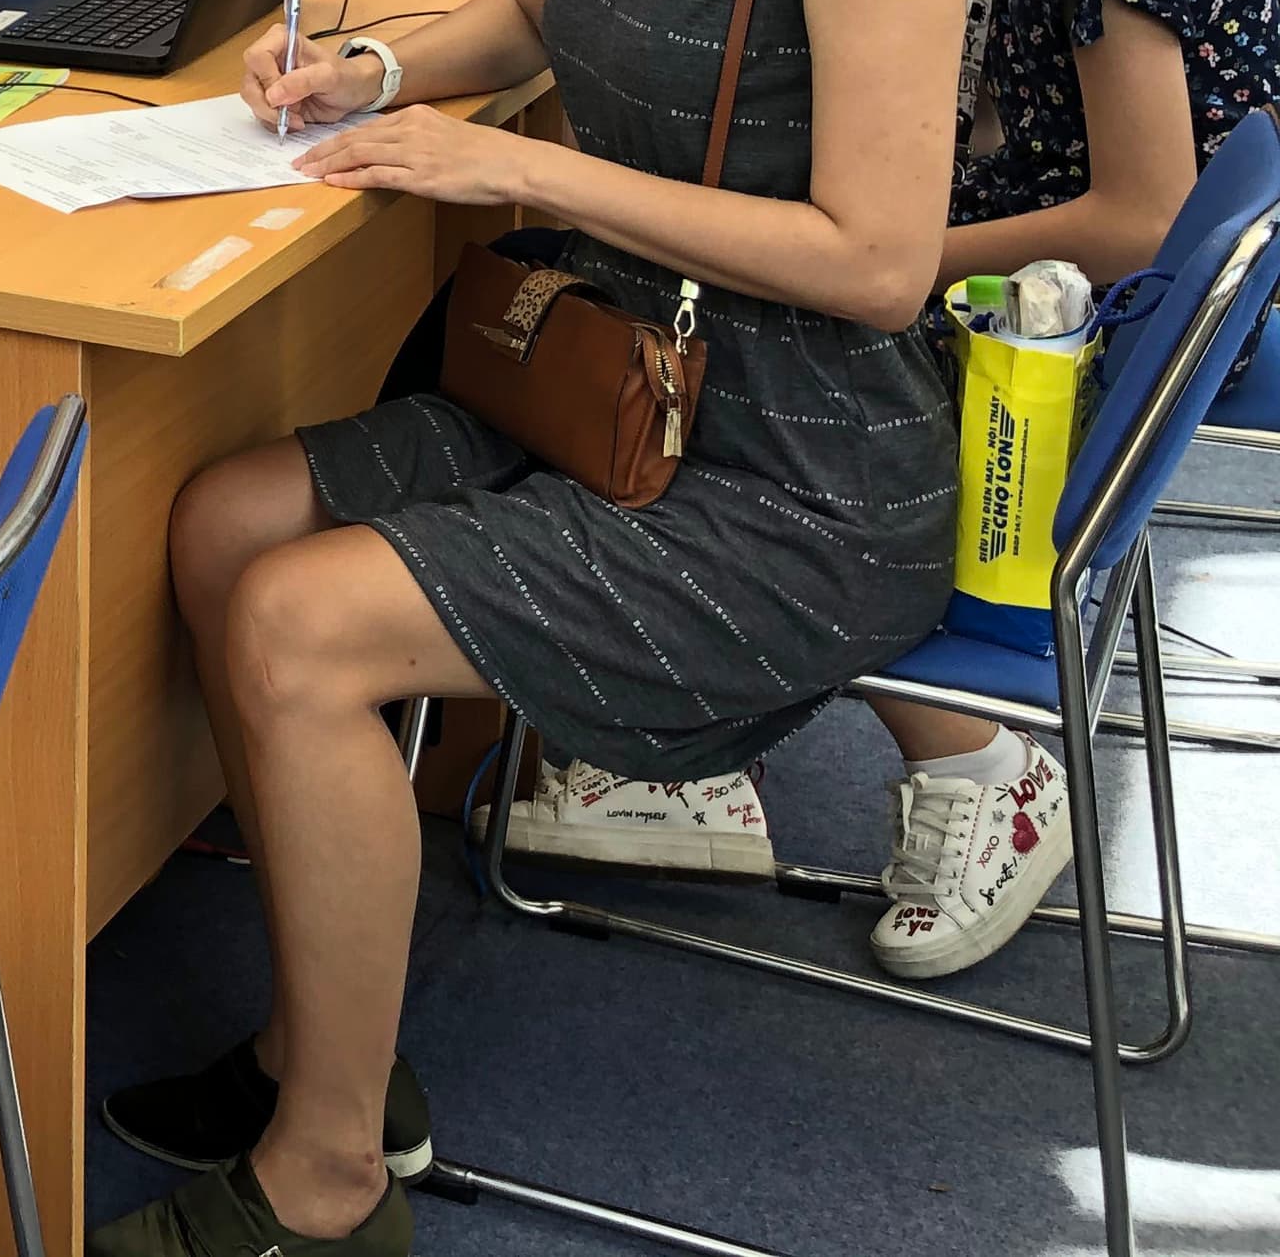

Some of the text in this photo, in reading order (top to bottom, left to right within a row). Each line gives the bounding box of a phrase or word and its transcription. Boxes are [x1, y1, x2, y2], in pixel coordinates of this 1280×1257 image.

[1008, 755, 1054, 809] LOVE
[607, 810, 633, 819] LOVIN
[976, 835, 1000, 868] XOXO
